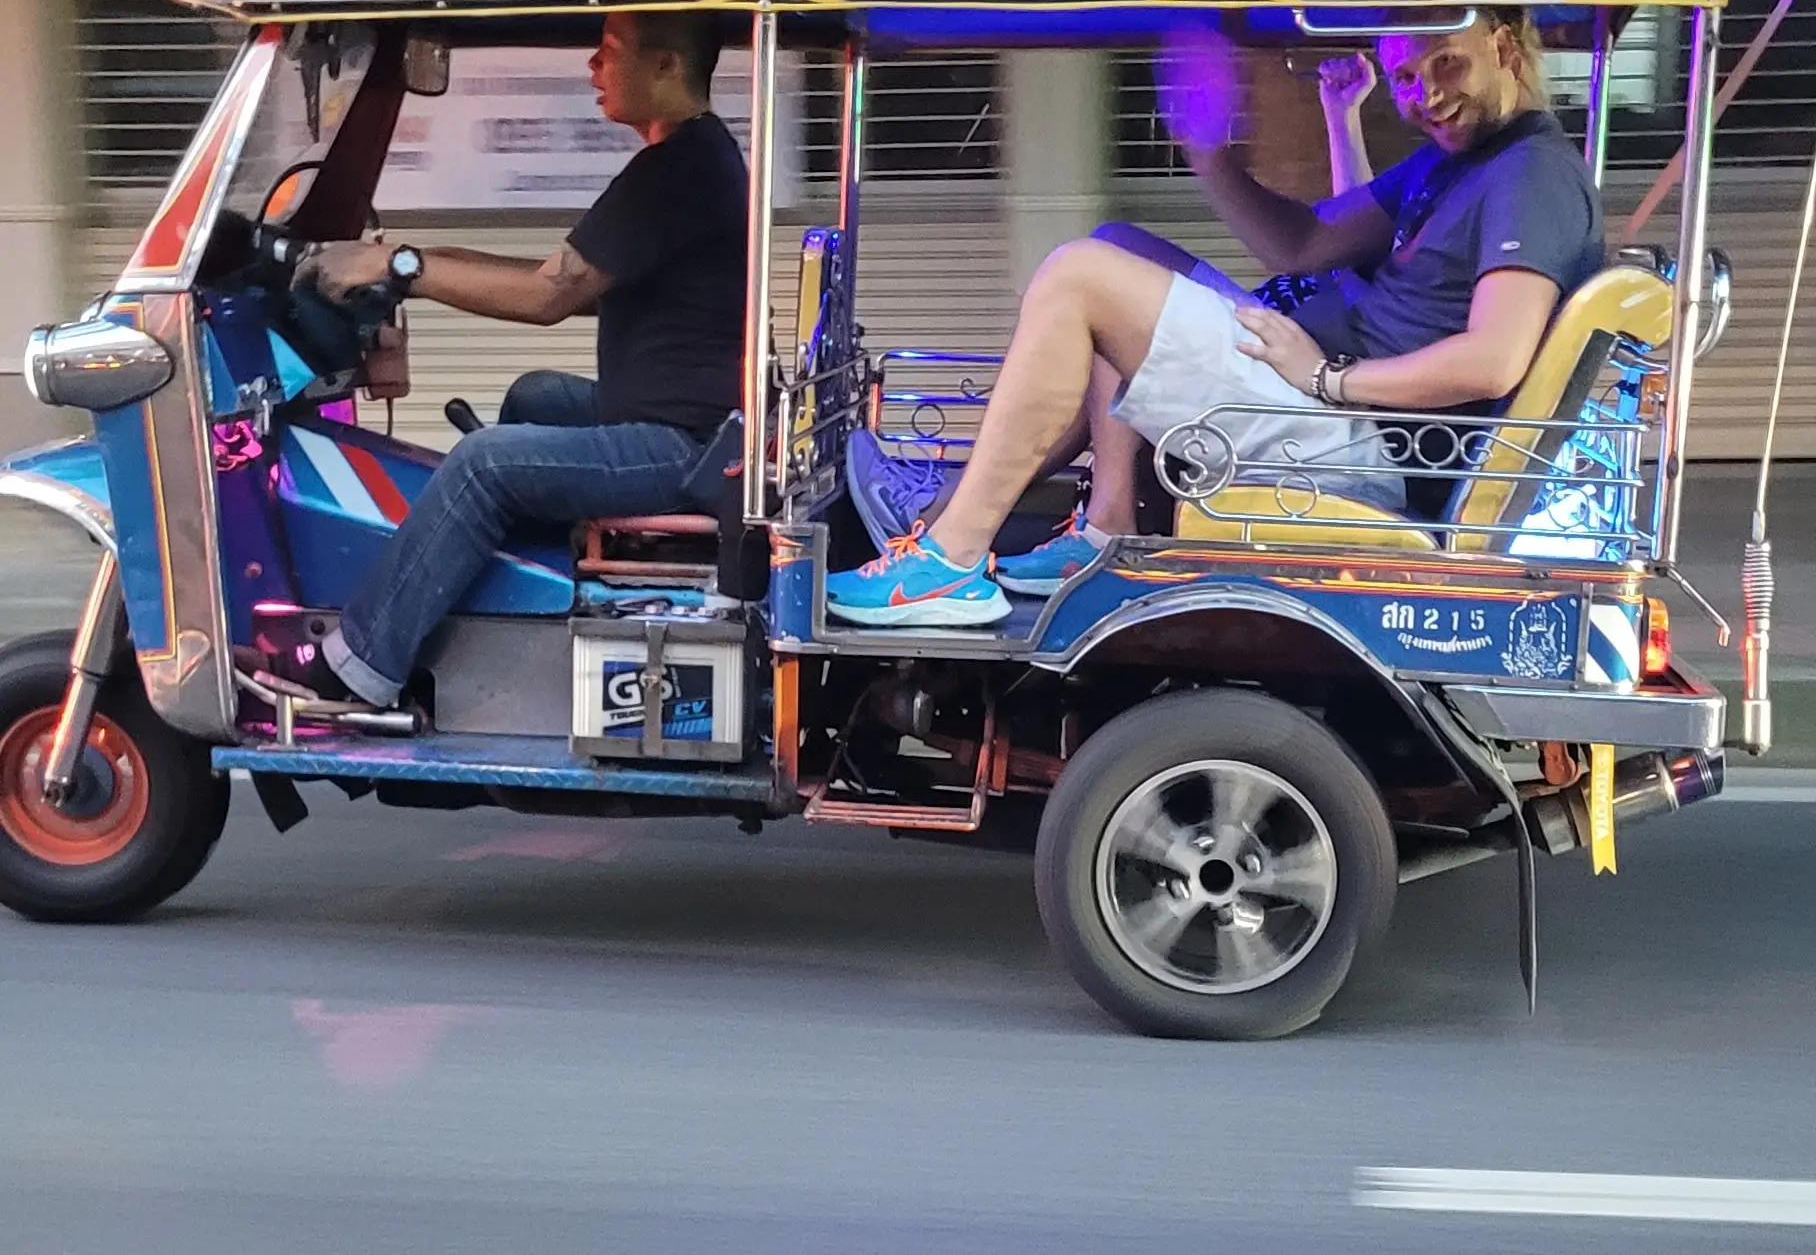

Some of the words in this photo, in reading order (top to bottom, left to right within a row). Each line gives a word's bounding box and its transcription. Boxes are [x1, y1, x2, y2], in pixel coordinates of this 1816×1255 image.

[1382, 601, 1415, 629] สก
[1397, 632, 1493, 653] กรุงเทพมหานคร
[675, 700, 707, 716] CV
[1595, 768, 1609, 841] TOYOTA
